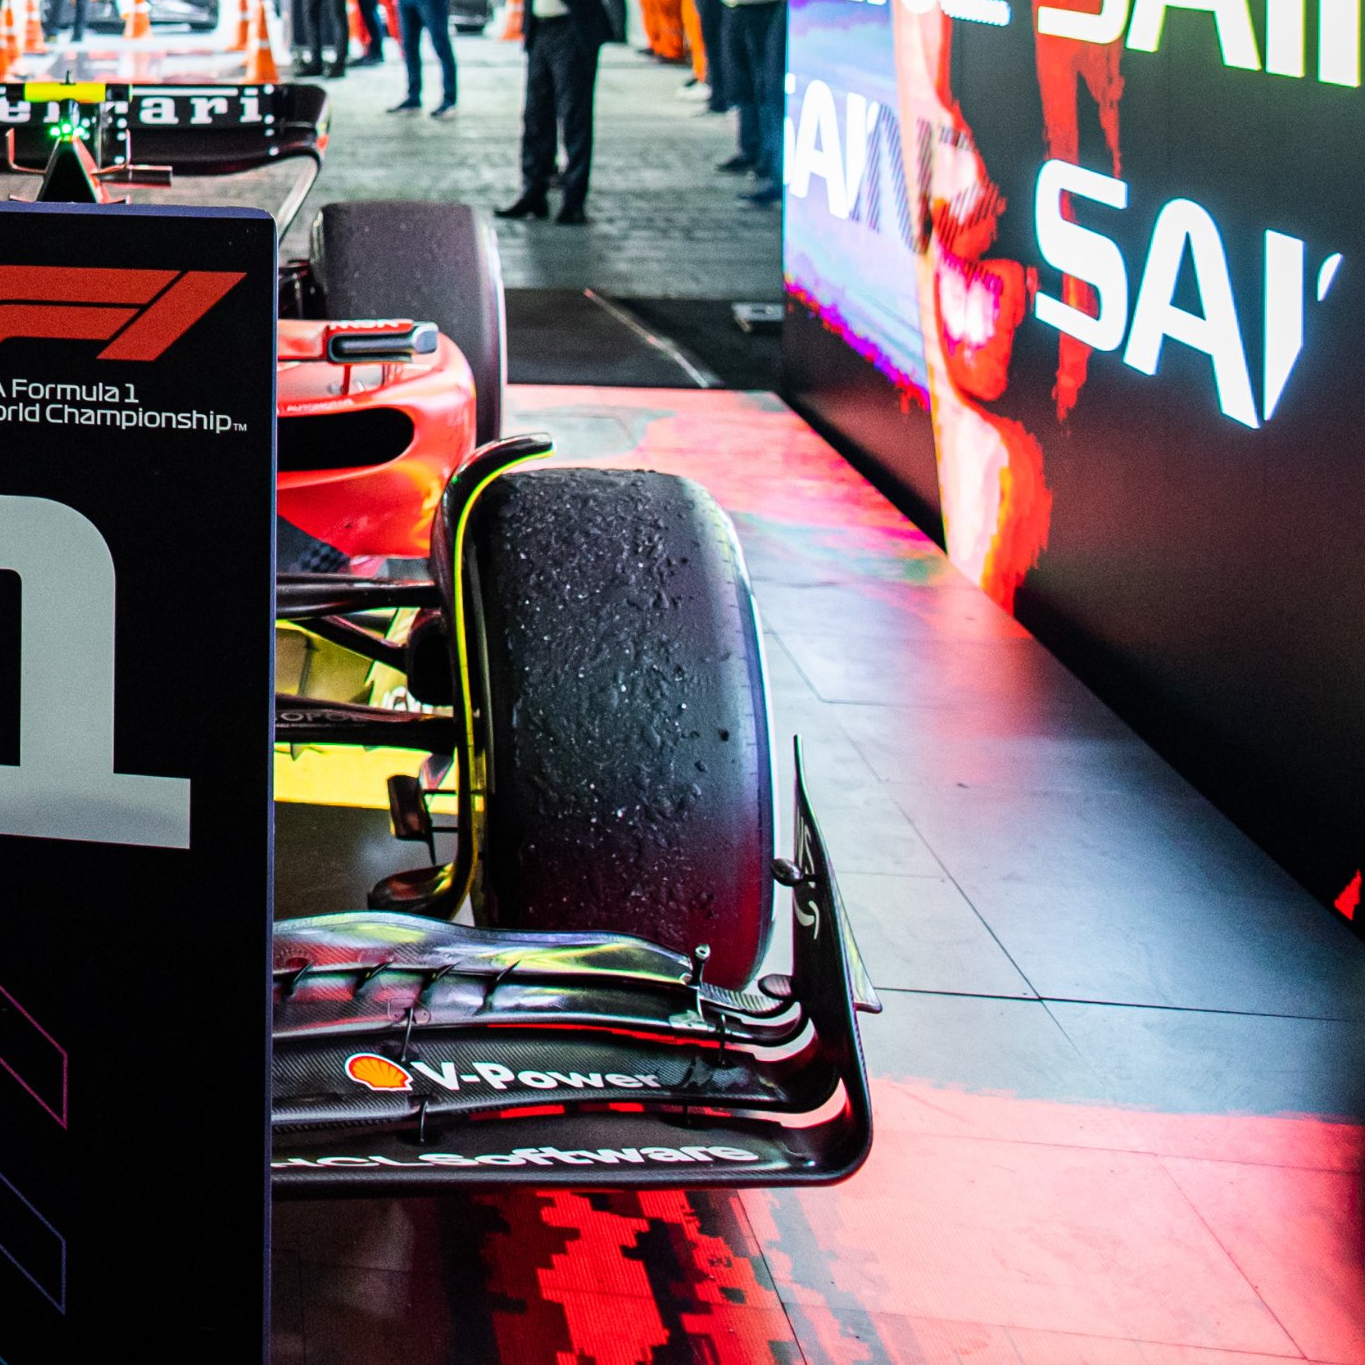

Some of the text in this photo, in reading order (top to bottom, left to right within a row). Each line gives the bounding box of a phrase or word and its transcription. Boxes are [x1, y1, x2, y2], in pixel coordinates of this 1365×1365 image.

[12, 378, 120, 403] Formula
[124, 383, 140, 403] 1
[410, 1059, 663, 1092] V-Power
